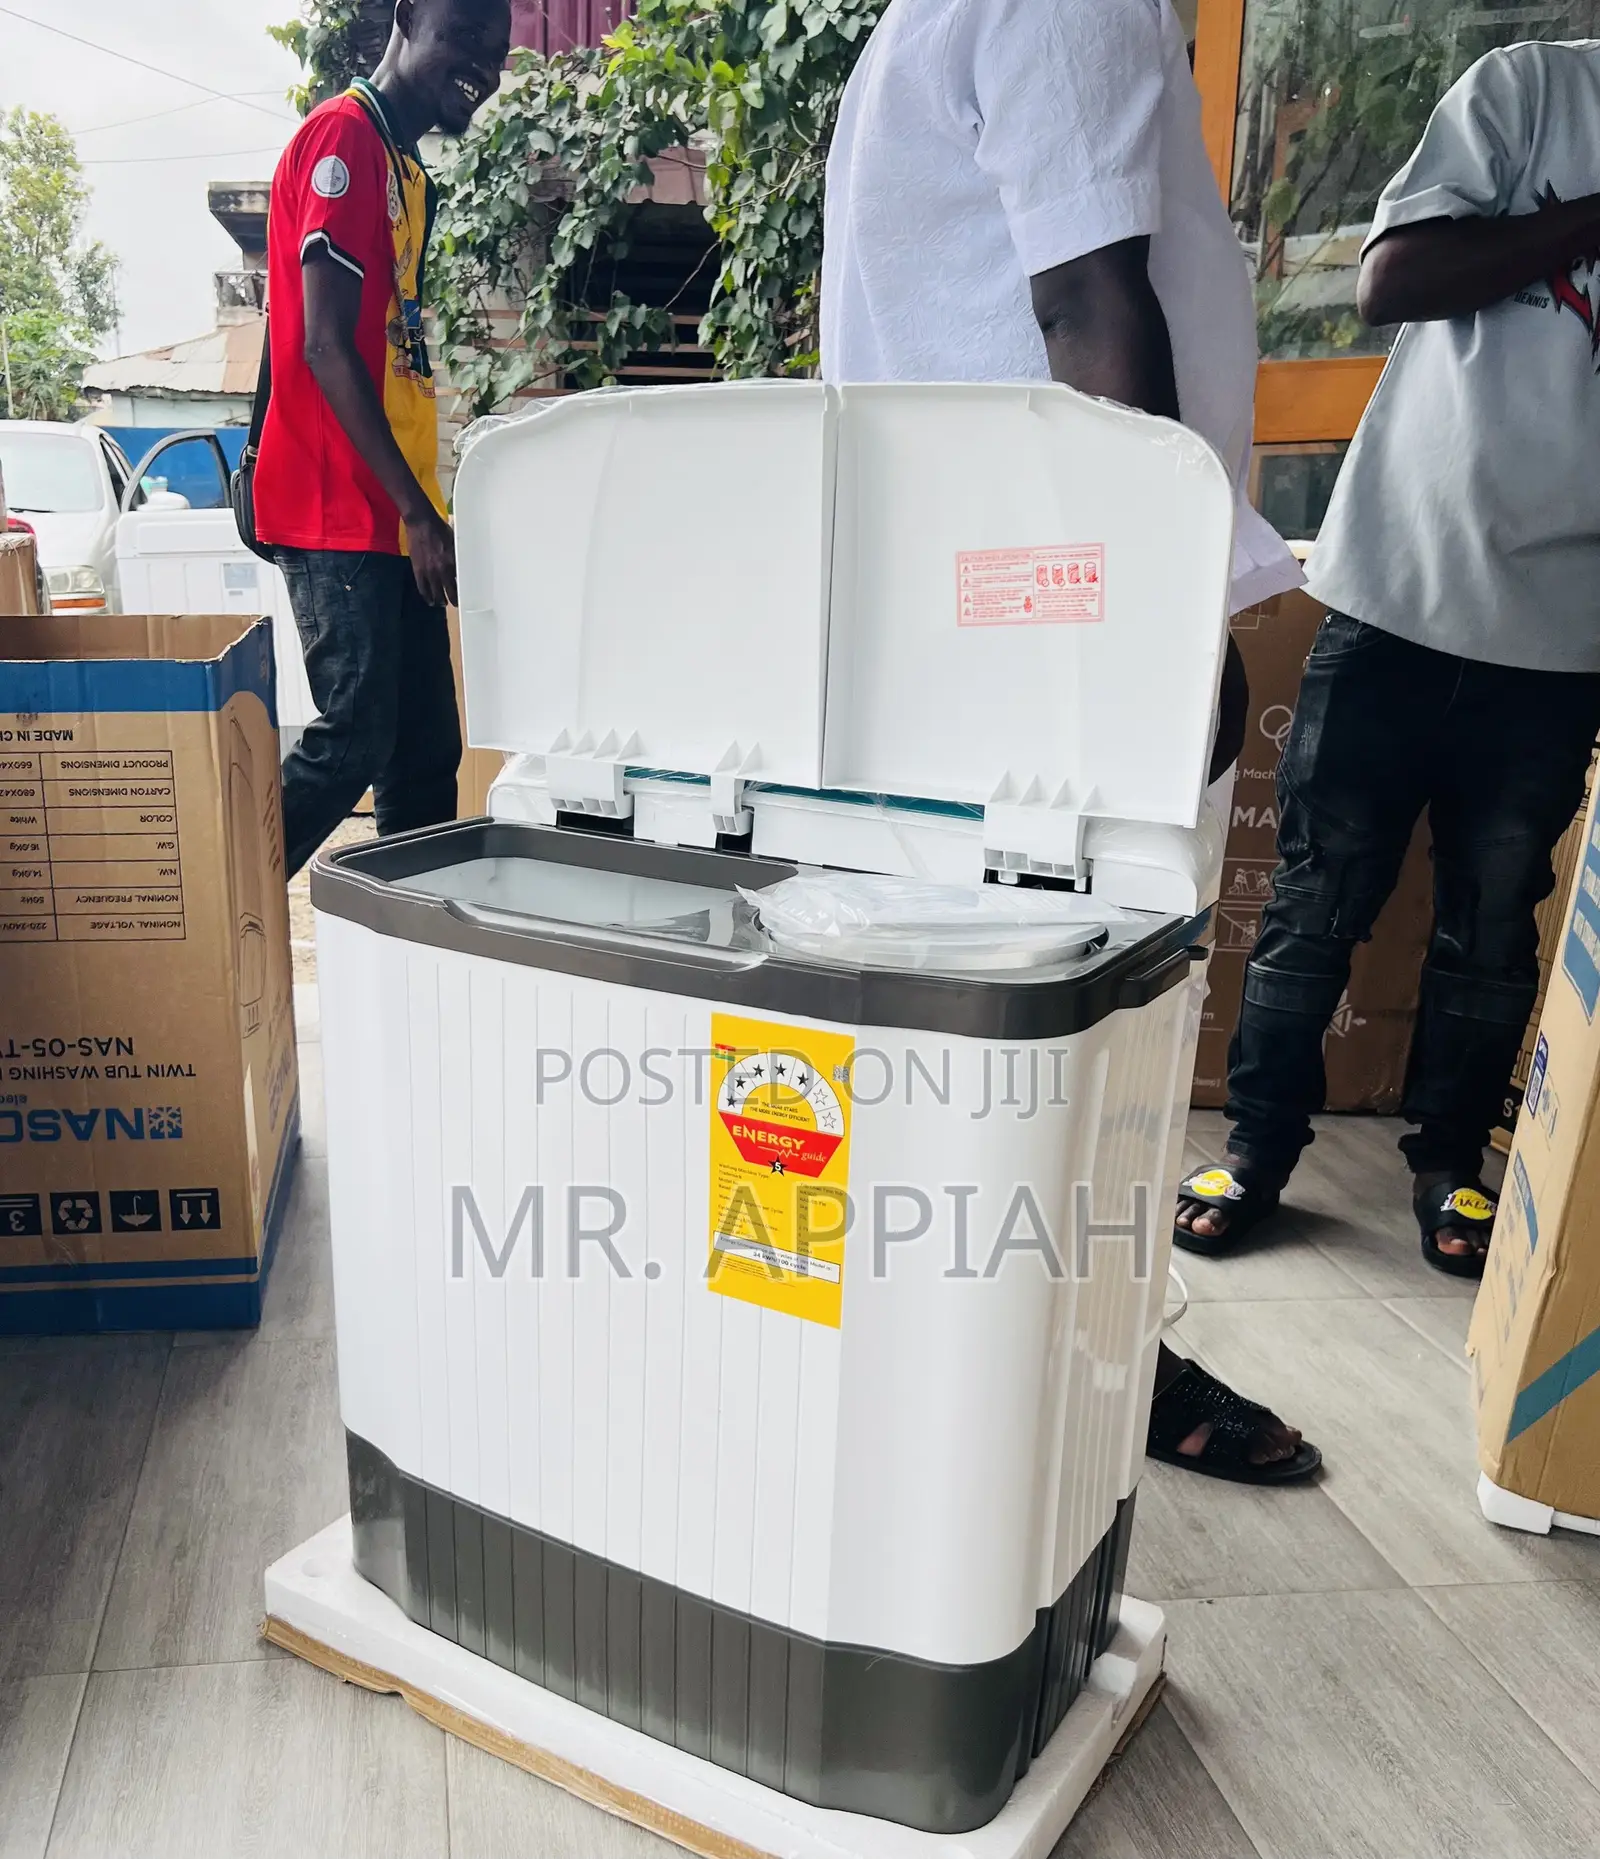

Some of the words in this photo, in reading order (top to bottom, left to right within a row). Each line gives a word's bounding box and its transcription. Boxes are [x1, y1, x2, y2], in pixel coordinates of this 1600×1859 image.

[1514, 292, 1550, 309] DENNIS
[17, 730, 30, 742] IN
[34, 729, 74, 741] MADE
[0, 761, 33, 770] 660X4
[60, 760, 120, 769] DIMENSIONS
[122, 760, 169, 769] PRODUCT
[1242, 768, 1276, 780] Mach
[68, 788, 128, 797] DIMENSIONS
[130, 787, 171, 796] CARTON
[9, 815, 37, 824] White
[139, 814, 173, 823] COLOR
[75, 894, 133, 903] FREQUENCY
[136, 894, 179, 903] NOMINAL
[90, 921, 135, 930] VOLTAGE
[138, 920, 181, 929] NOMINAL
[0, 1037, 134, 1058] NAS-05-T
[9, 1065, 99, 1081] WASHING
[105, 1065, 142, 1079] TUB
[147, 1064, 196, 1078] TWIN
[732, 1124, 806, 1151] ENERGY
[800, 1151, 827, 1163] guide
[774, 1161, 782, 1171] 5
